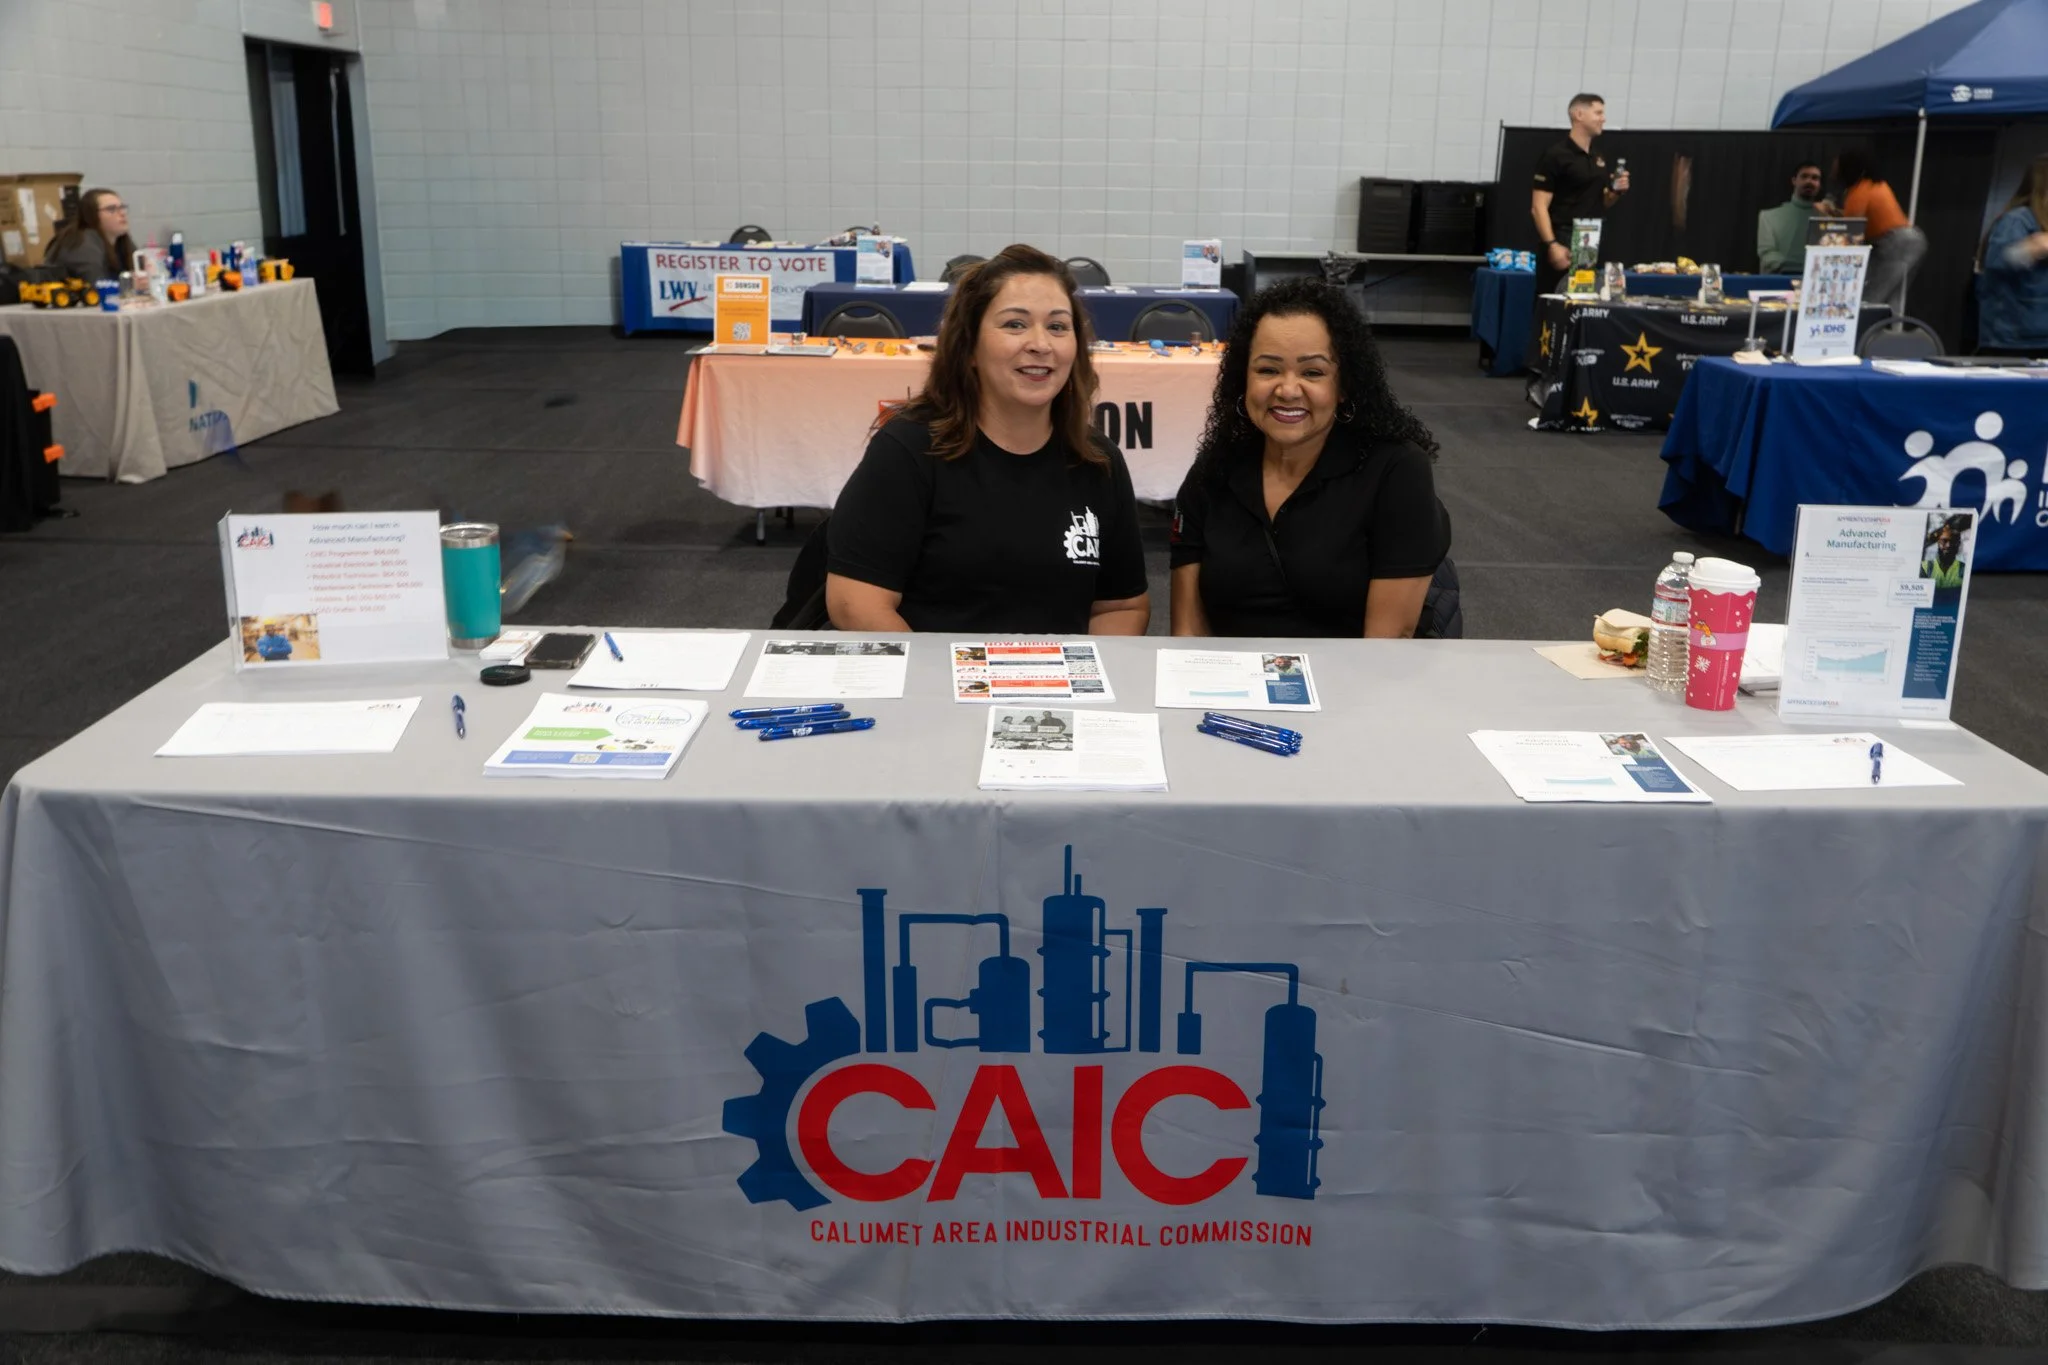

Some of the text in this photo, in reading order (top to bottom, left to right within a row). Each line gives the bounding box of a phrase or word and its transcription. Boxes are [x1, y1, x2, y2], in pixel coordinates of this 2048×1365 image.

[655, 253, 827, 272] REGISTER TO VOTE
[659, 280, 698, 300] LWV
[1582, 307, 1610, 319] ARMY
[1698, 314, 1729, 326] ARMY
[1611, 376, 1660, 390] U.S. ARMY
[1094, 401, 1153, 450] ON
[1839, 528, 1888, 539] Advanced
[1826, 539, 1897, 552] Manufacturing
[797, 1063, 1252, 1206] CAIC
[810, 1220, 1313, 1248] CALUMET AREA INDUSTRIAL COMMISSION
